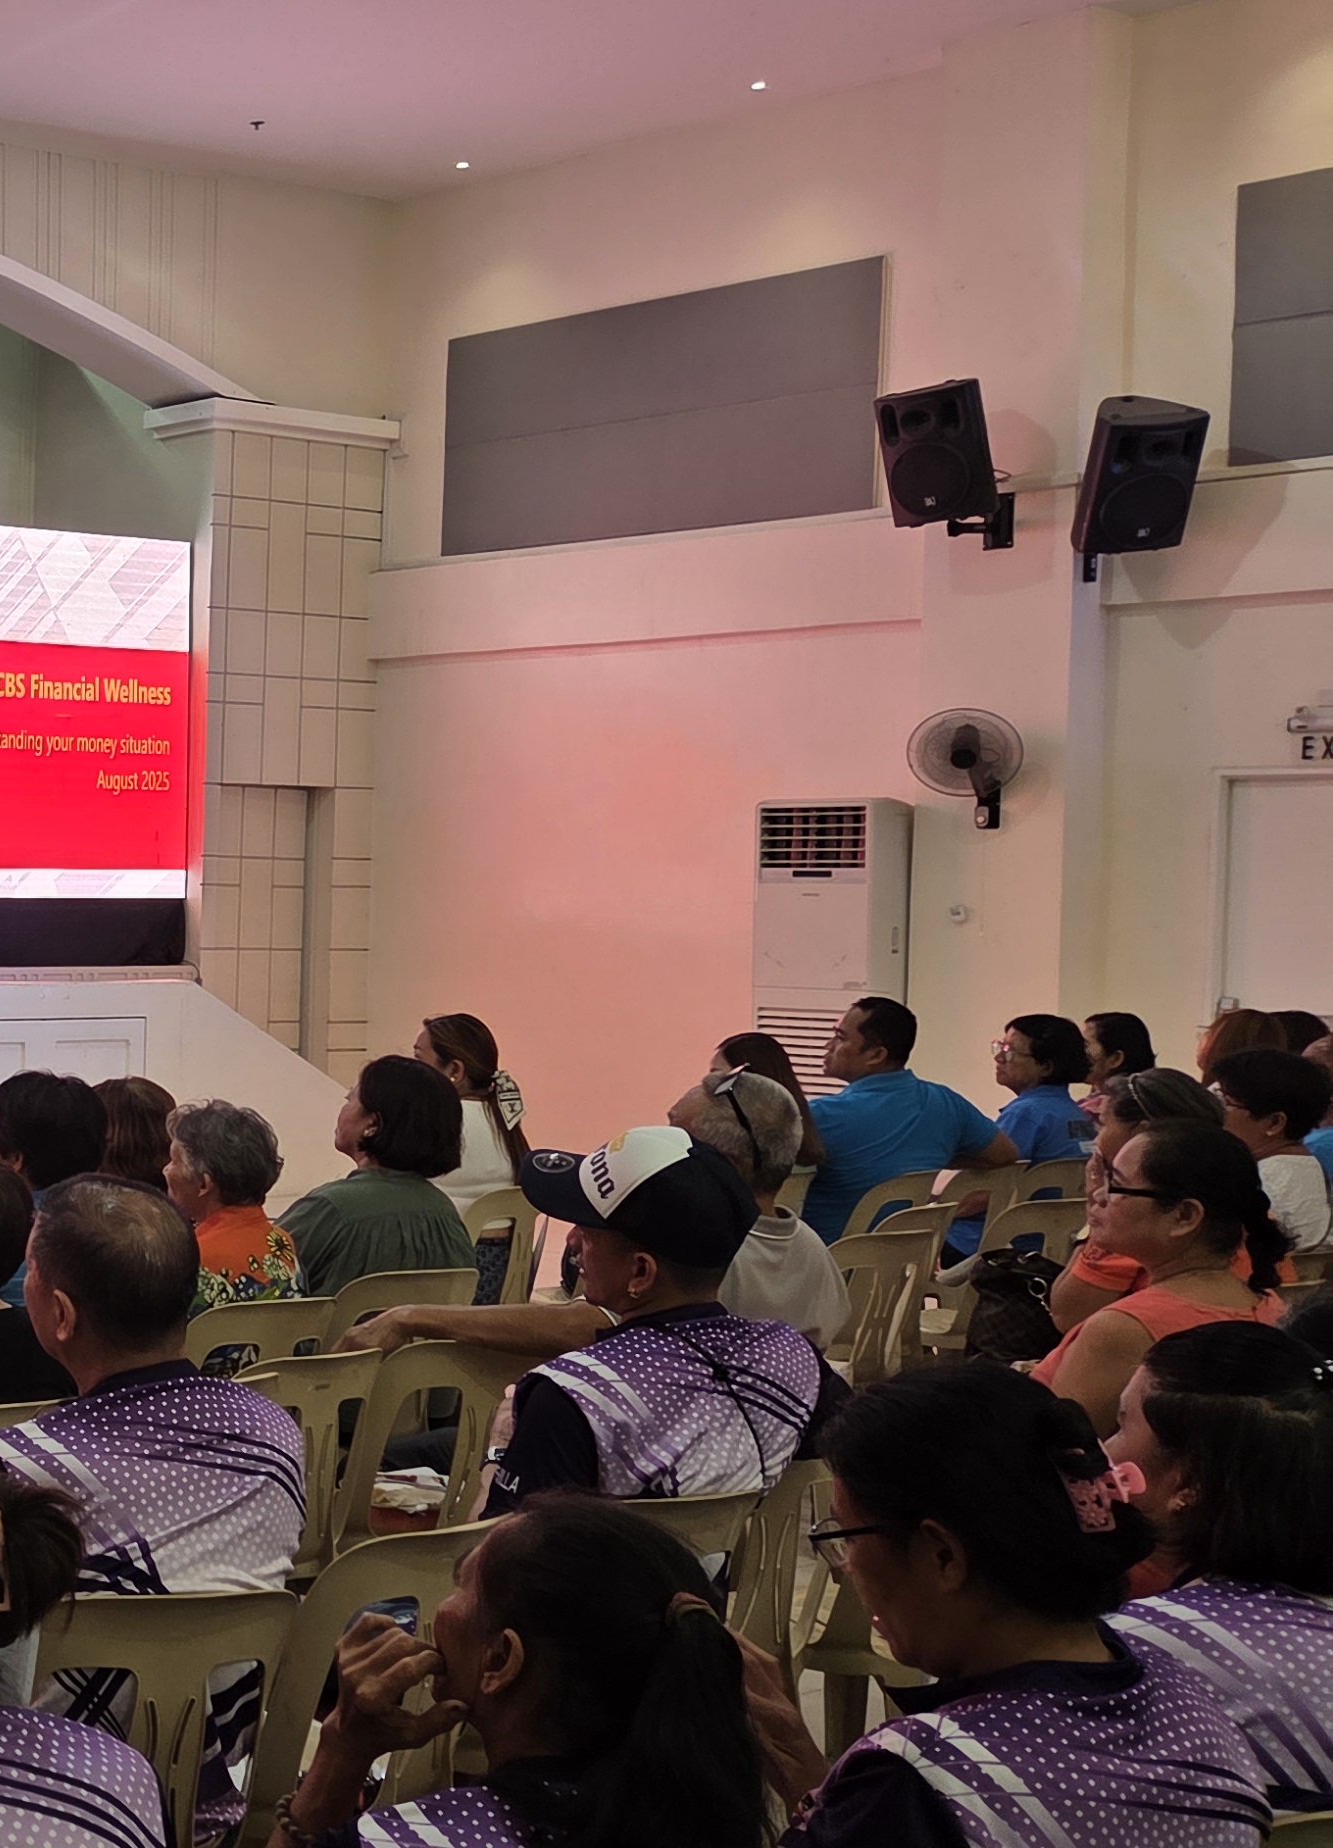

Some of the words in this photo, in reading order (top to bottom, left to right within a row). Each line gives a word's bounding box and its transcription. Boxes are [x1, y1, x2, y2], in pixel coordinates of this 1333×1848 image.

[30, 673, 100, 702] Financial
[103, 677, 172, 706] Wellness
[46, 735, 74, 757] your
[76, 736, 118, 760] money
[120, 733, 171, 756] situation
[96, 769, 139, 796] August
[141, 770, 170, 791] 2025
